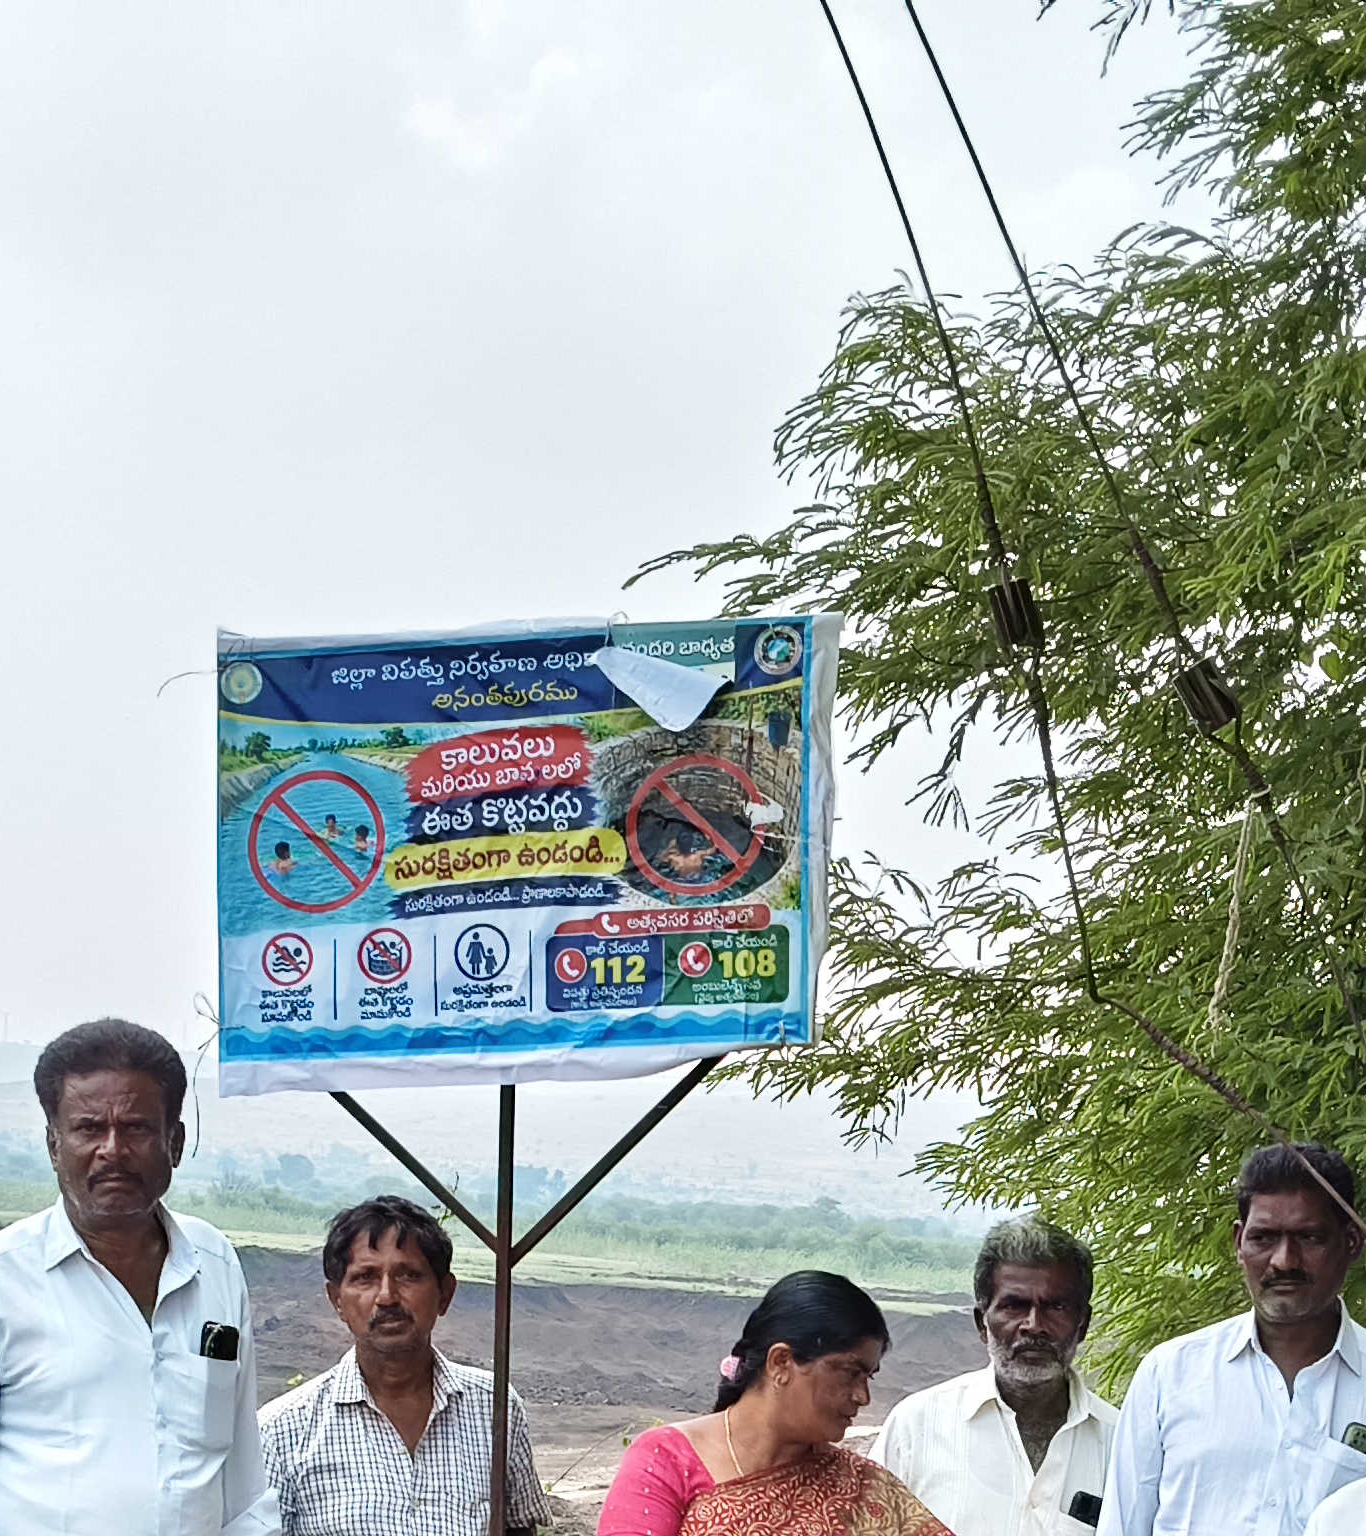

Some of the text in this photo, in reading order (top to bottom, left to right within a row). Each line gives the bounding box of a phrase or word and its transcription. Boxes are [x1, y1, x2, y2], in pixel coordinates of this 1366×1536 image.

[678, 635, 736, 661] బాధ్యత
[331, 667, 376, 691] జిల్లా
[381, 656, 445, 686] విపత్తు
[448, 650, 538, 681] నిర్వహణ
[432, 680, 578, 712] అనంతపురము
[440, 732, 556, 771] కాలువలు
[420, 768, 491, 799] మరియు
[421, 789, 583, 837] ఈత కొట్టవద్దు
[394, 847, 511, 881] సురక్షితంగా
[626, 911, 690, 934] అత్యవసర
[590, 954, 646, 985] 112
[718, 949, 777, 979] 108
